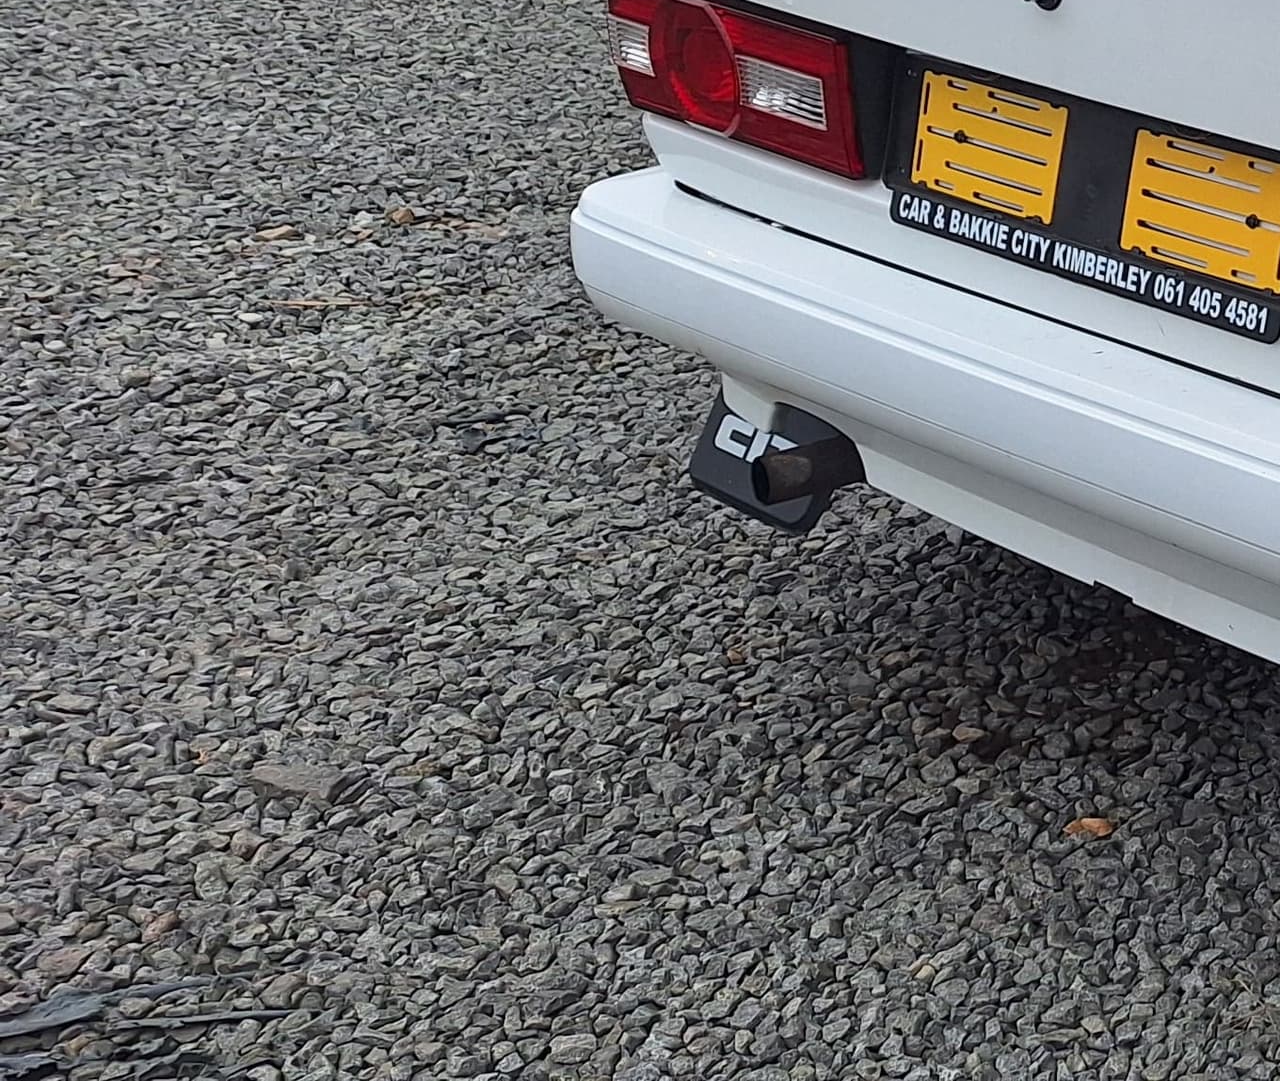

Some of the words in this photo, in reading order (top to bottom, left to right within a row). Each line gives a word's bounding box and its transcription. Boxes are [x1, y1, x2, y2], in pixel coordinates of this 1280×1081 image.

[899, 193, 931, 226] CAR
[934, 204, 946, 229] &
[949, 209, 1010, 251] BAKKIE
[1011, 229, 1050, 263] CITY
[1052, 241, 1152, 295] KIMBERLEY
[1153, 274, 1185, 307] 061
[1188, 286, 1222, 319] 405
[1224, 297, 1268, 334] 4581
[714, 413, 799, 464] CI
